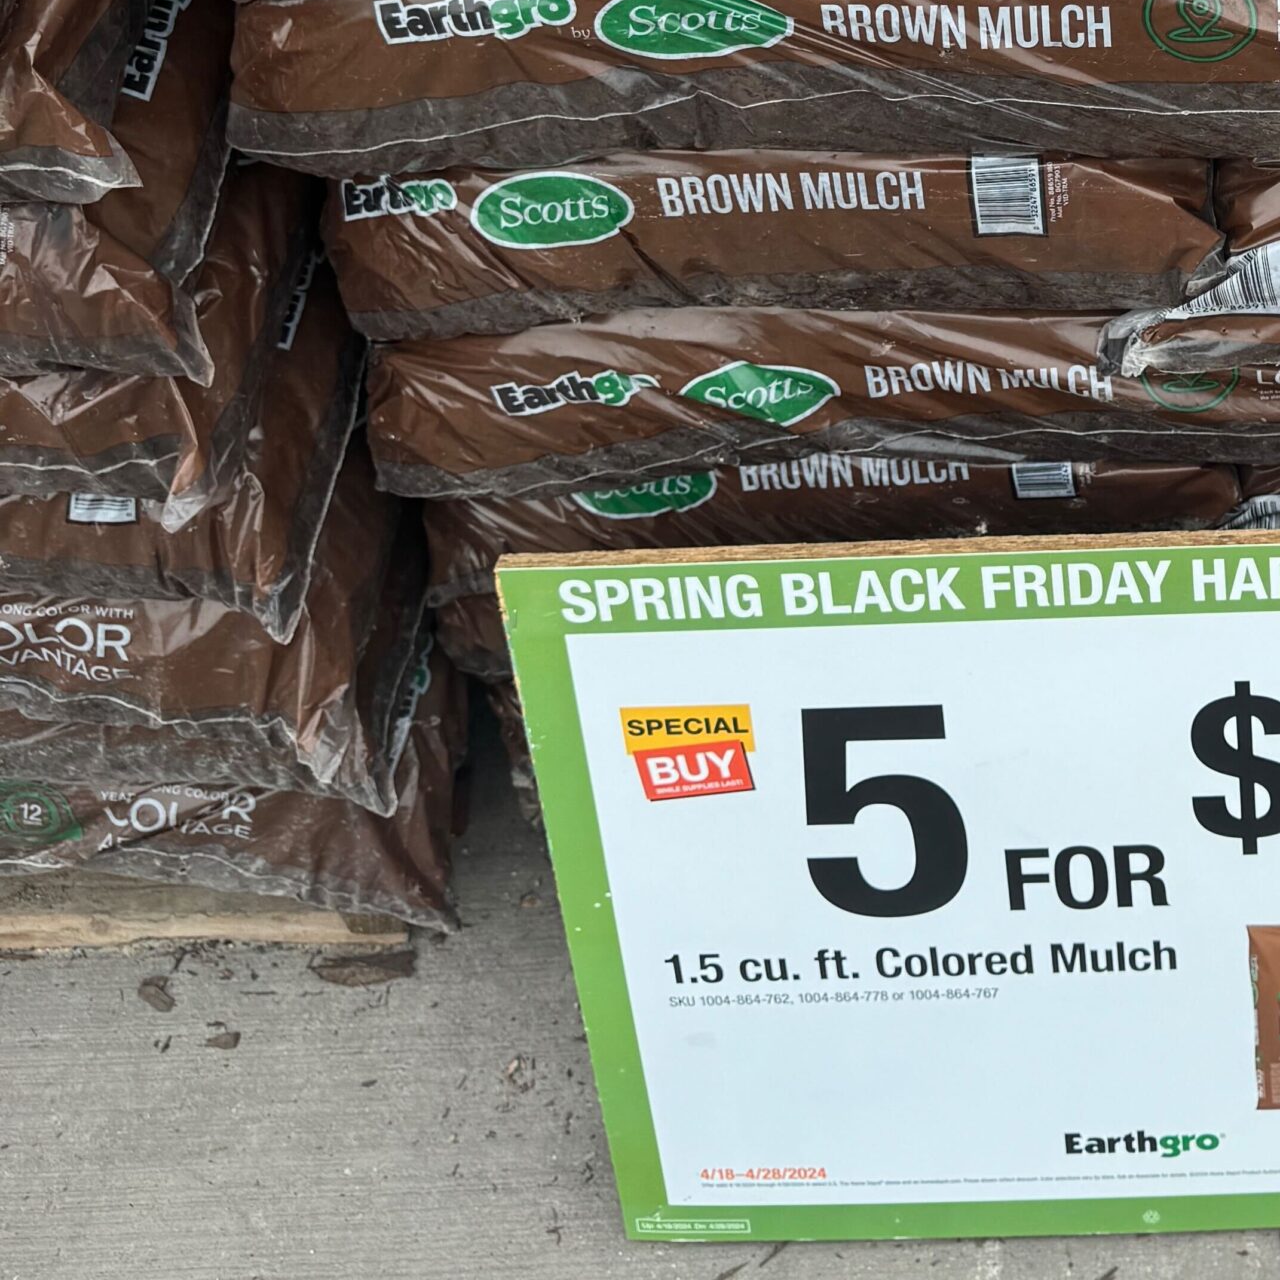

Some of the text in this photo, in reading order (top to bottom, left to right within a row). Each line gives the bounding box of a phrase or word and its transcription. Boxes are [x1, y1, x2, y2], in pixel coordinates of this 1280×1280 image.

[571, 25, 590, 40] by
[626, 4, 765, 38] Scotts
[820, 3, 967, 48] BROWN
[980, 6, 1112, 49] MULCH
[95, 605, 134, 619] WITH
[558, 573, 762, 624] SPRING
[782, 566, 965, 616] BLACK
[982, 559, 1171, 609] FRIDAY
[0, 618, 131, 663] OLOR
[627, 717, 749, 736] SPECIAL
[646, 748, 736, 786] BUY
[801, 704, 969, 919] 5
[1004, 843, 1171, 911] FOR
[665, 940, 1178, 985] 1.5 cu. ft. Colored Mulch
[669, 987, 999, 1008] SKU 1004-864-762, 1004-864-778 or 1004-864-767
[1064, 1130, 1221, 1158] Earthgro
